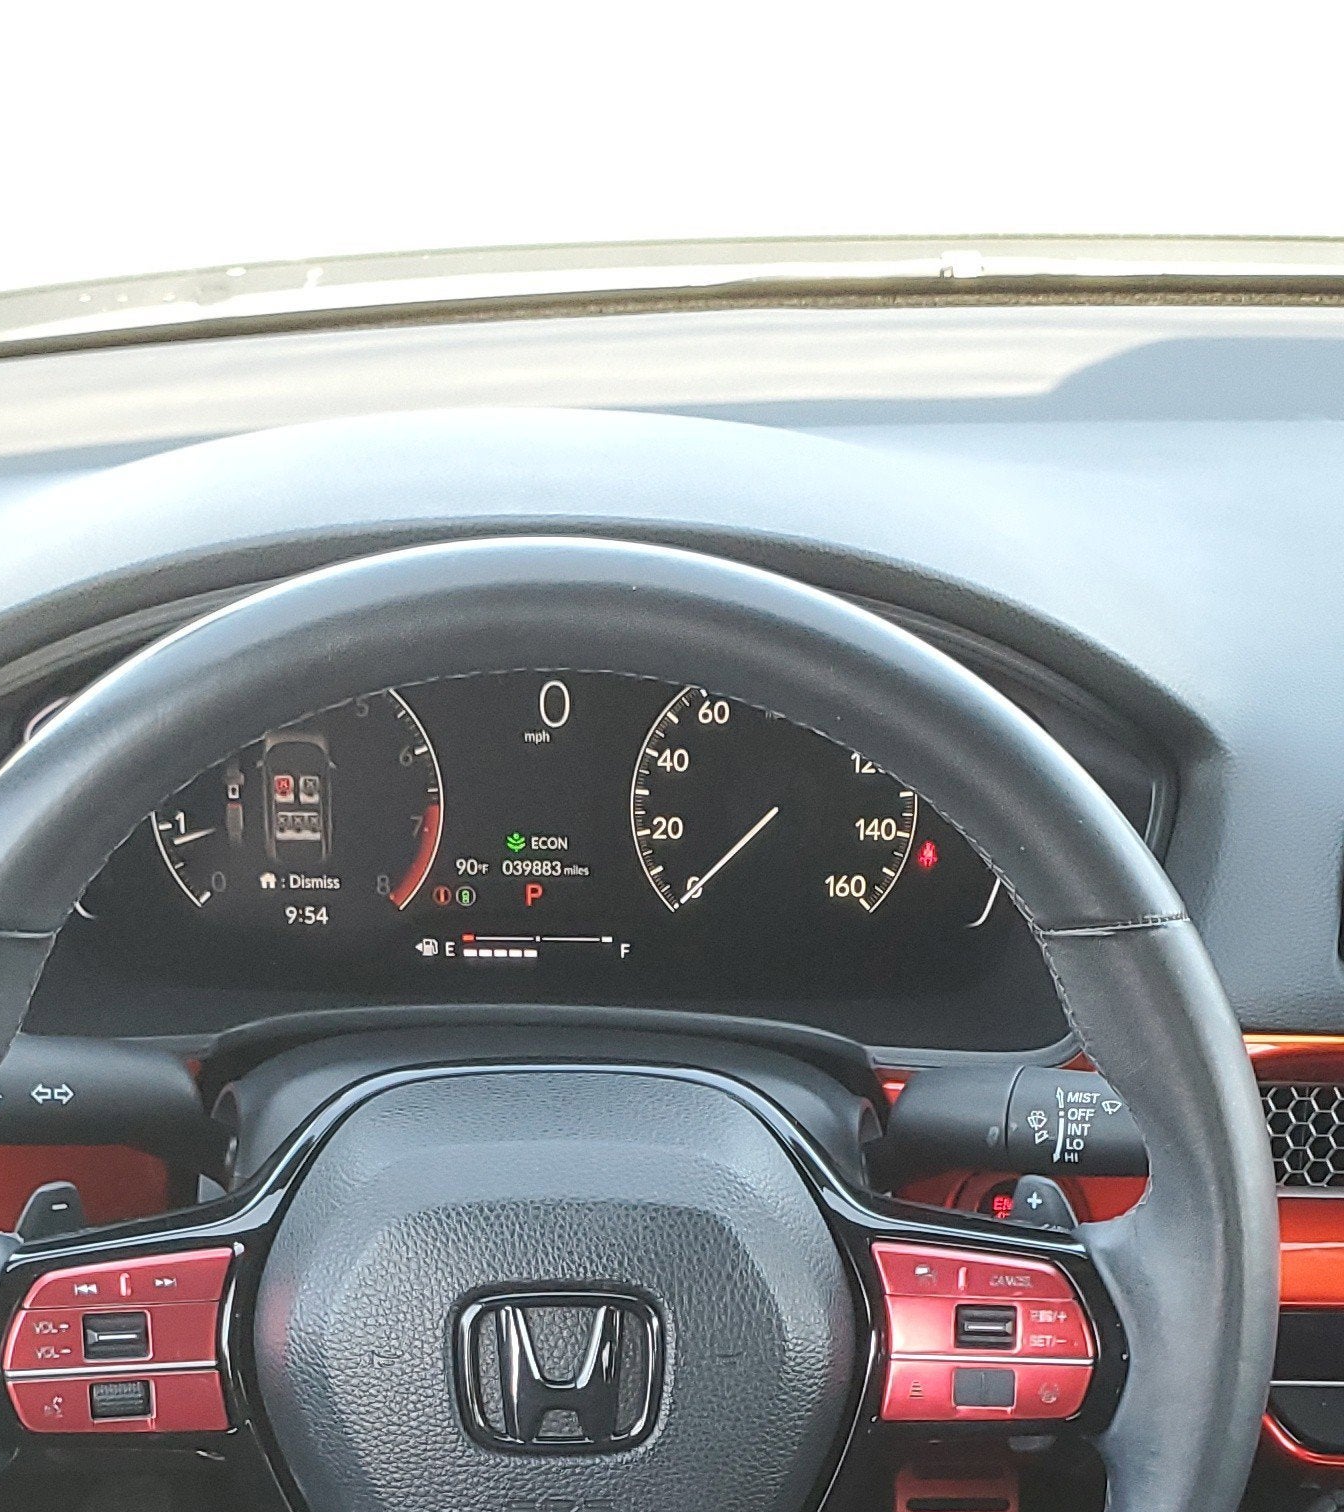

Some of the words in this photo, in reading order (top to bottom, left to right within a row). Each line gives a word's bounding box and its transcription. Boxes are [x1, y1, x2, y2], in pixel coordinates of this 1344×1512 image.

[538, 679, 571, 728] 0
[697, 700, 730, 725] 60
[524, 730, 550, 745] mph
[656, 748, 690, 773] 40
[651, 816, 684, 841] 20
[855, 817, 897, 842] 140
[530, 836, 569, 851] ECON
[502, 859, 562, 877] 039883
[563, 864, 590, 877] miles
[289, 873, 342, 890] Dismiss
[824, 874, 867, 899] 160
[525, 882, 544, 907] P
[284, 905, 330, 926] 9:54
[444, 941, 457, 957] E
[620, 943, 632, 959] F
[1066, 1091, 1101, 1105] MIST
[1067, 1107, 1096, 1121] OFF
[1067, 1123, 1092, 1137] INT
[1065, 1138, 1085, 1151] LO
[1064, 1151, 1079, 1163] HI
